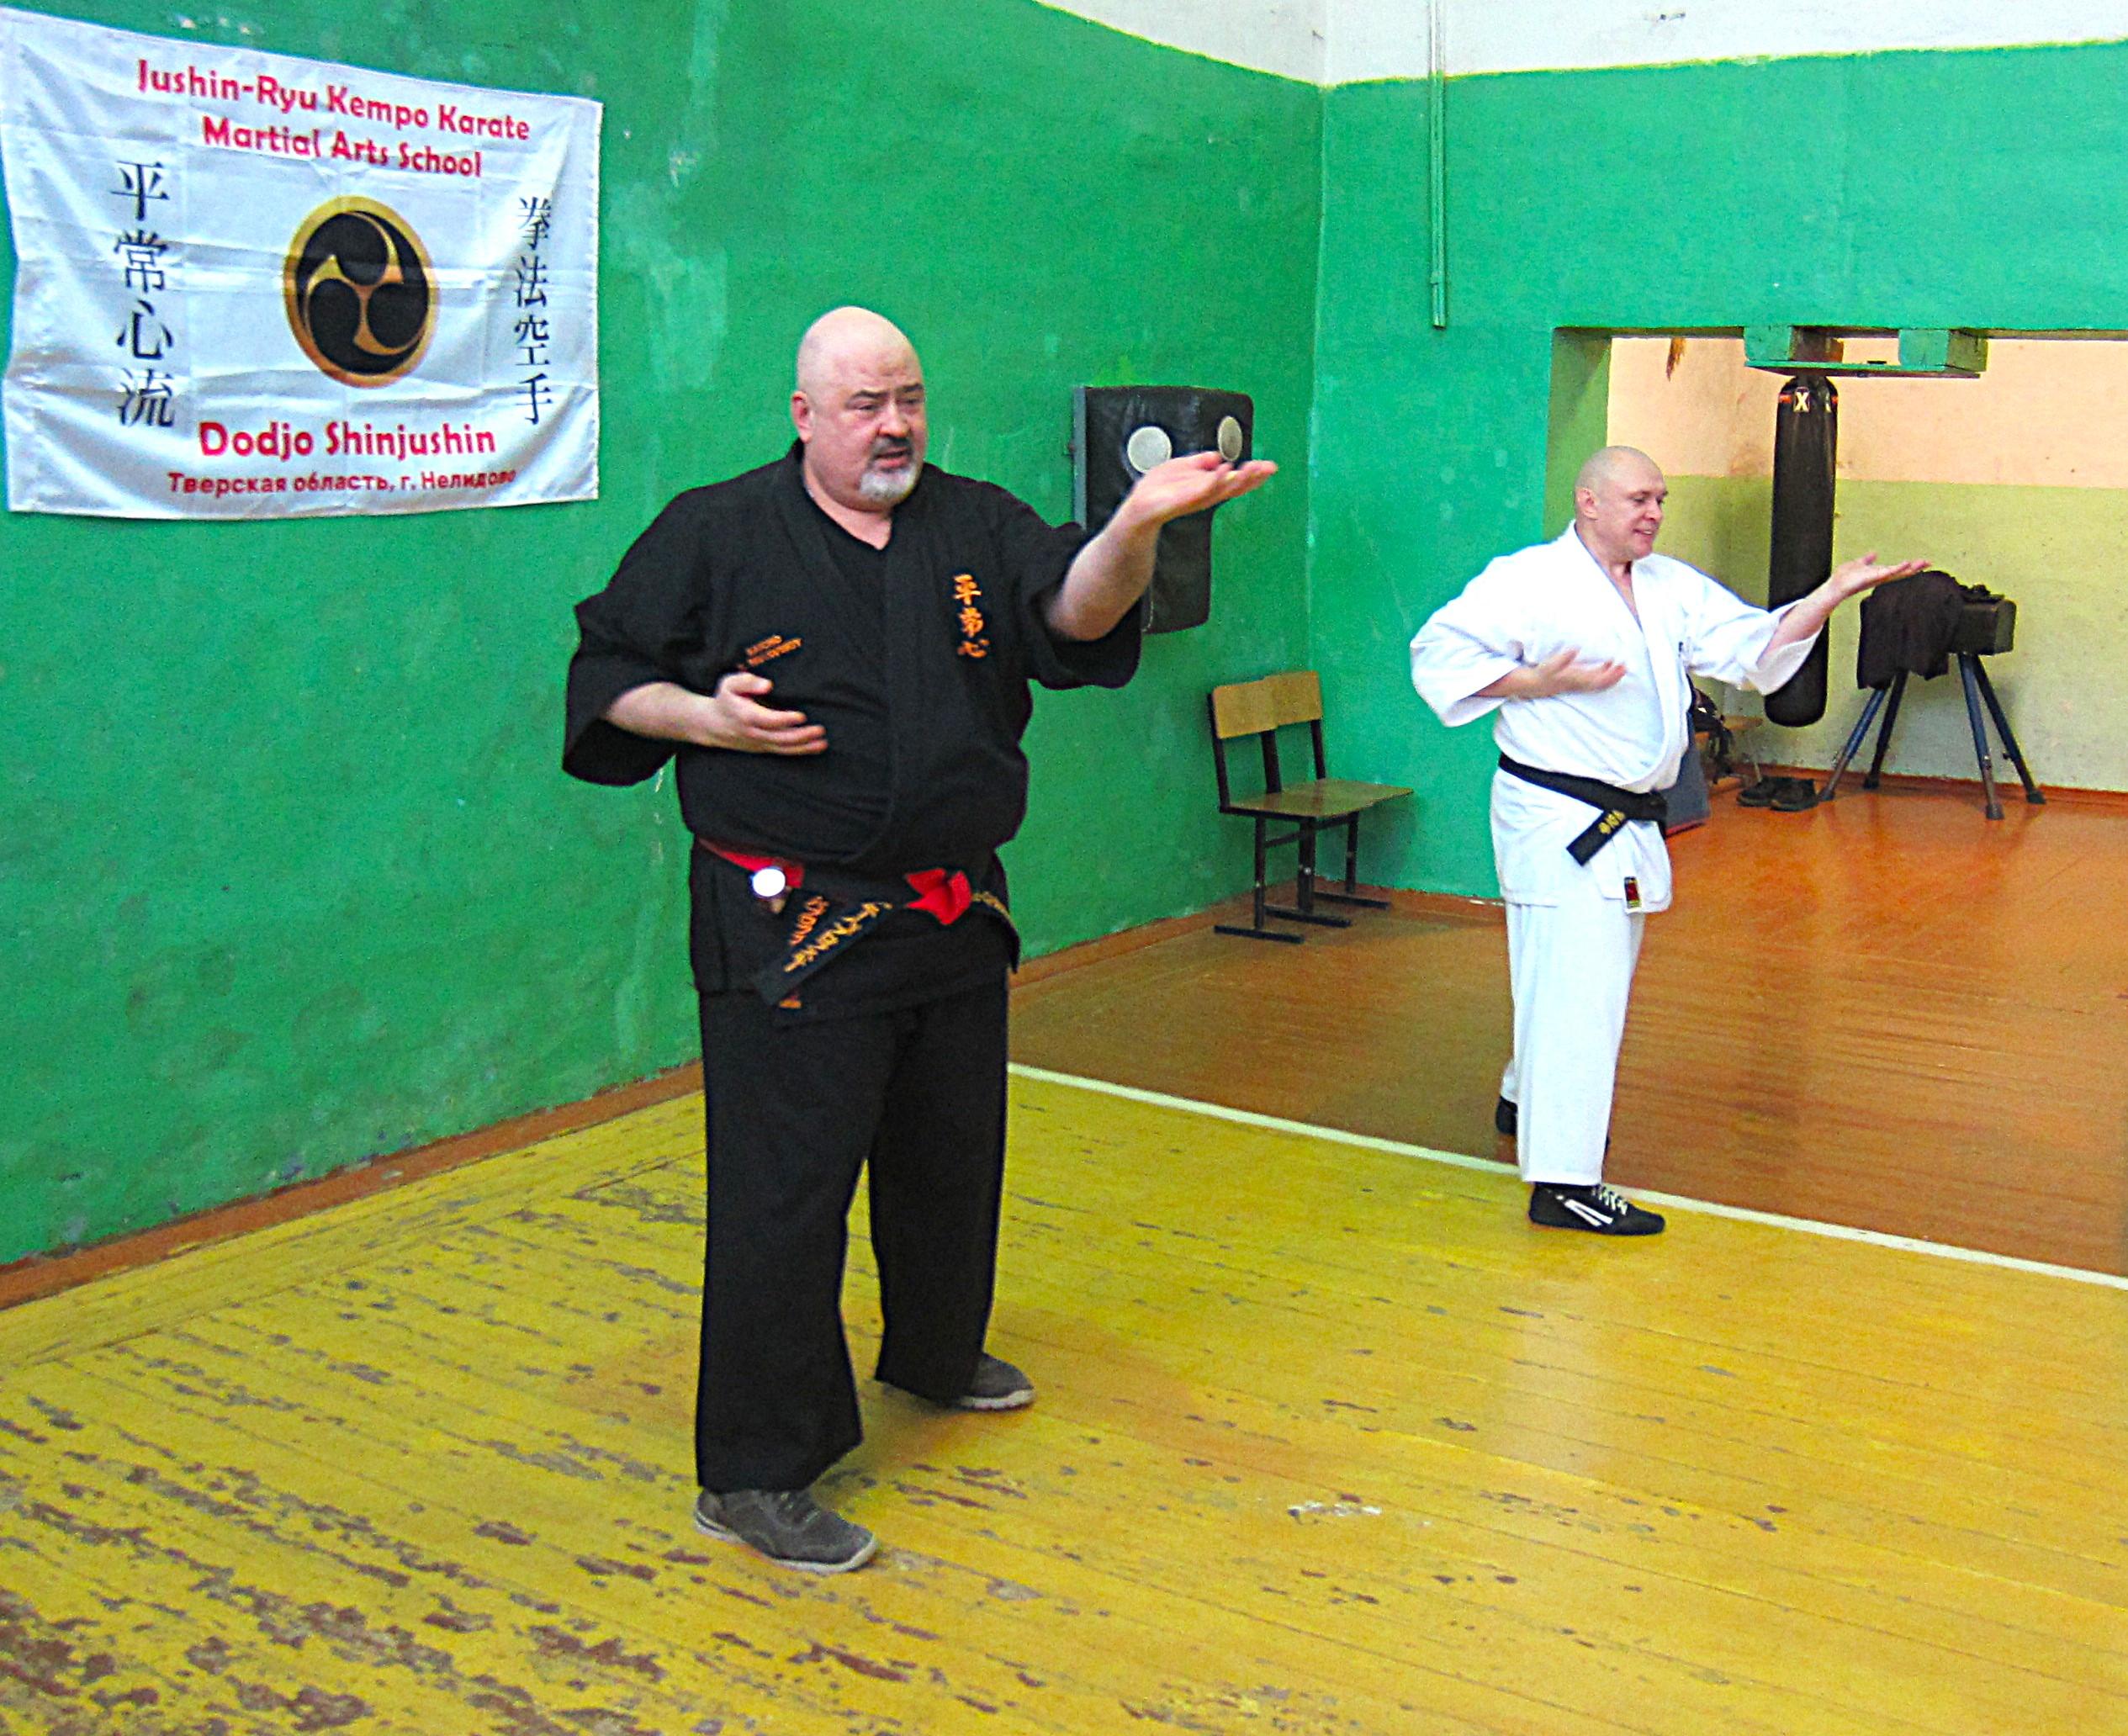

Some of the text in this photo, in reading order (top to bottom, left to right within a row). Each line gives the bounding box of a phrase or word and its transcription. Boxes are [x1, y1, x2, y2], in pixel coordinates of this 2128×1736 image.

[137, 59, 530, 140] Jushin-Ryu Kempo Karate
[202, 115, 482, 177] Martial Arts School
[110, 160, 175, 427] 平常心流
[514, 196, 553, 426] 拳法空手
[199, 421, 496, 462] Dodjo Shinjushin
[167, 469, 516, 498] Тверская область, г. Нелидово
